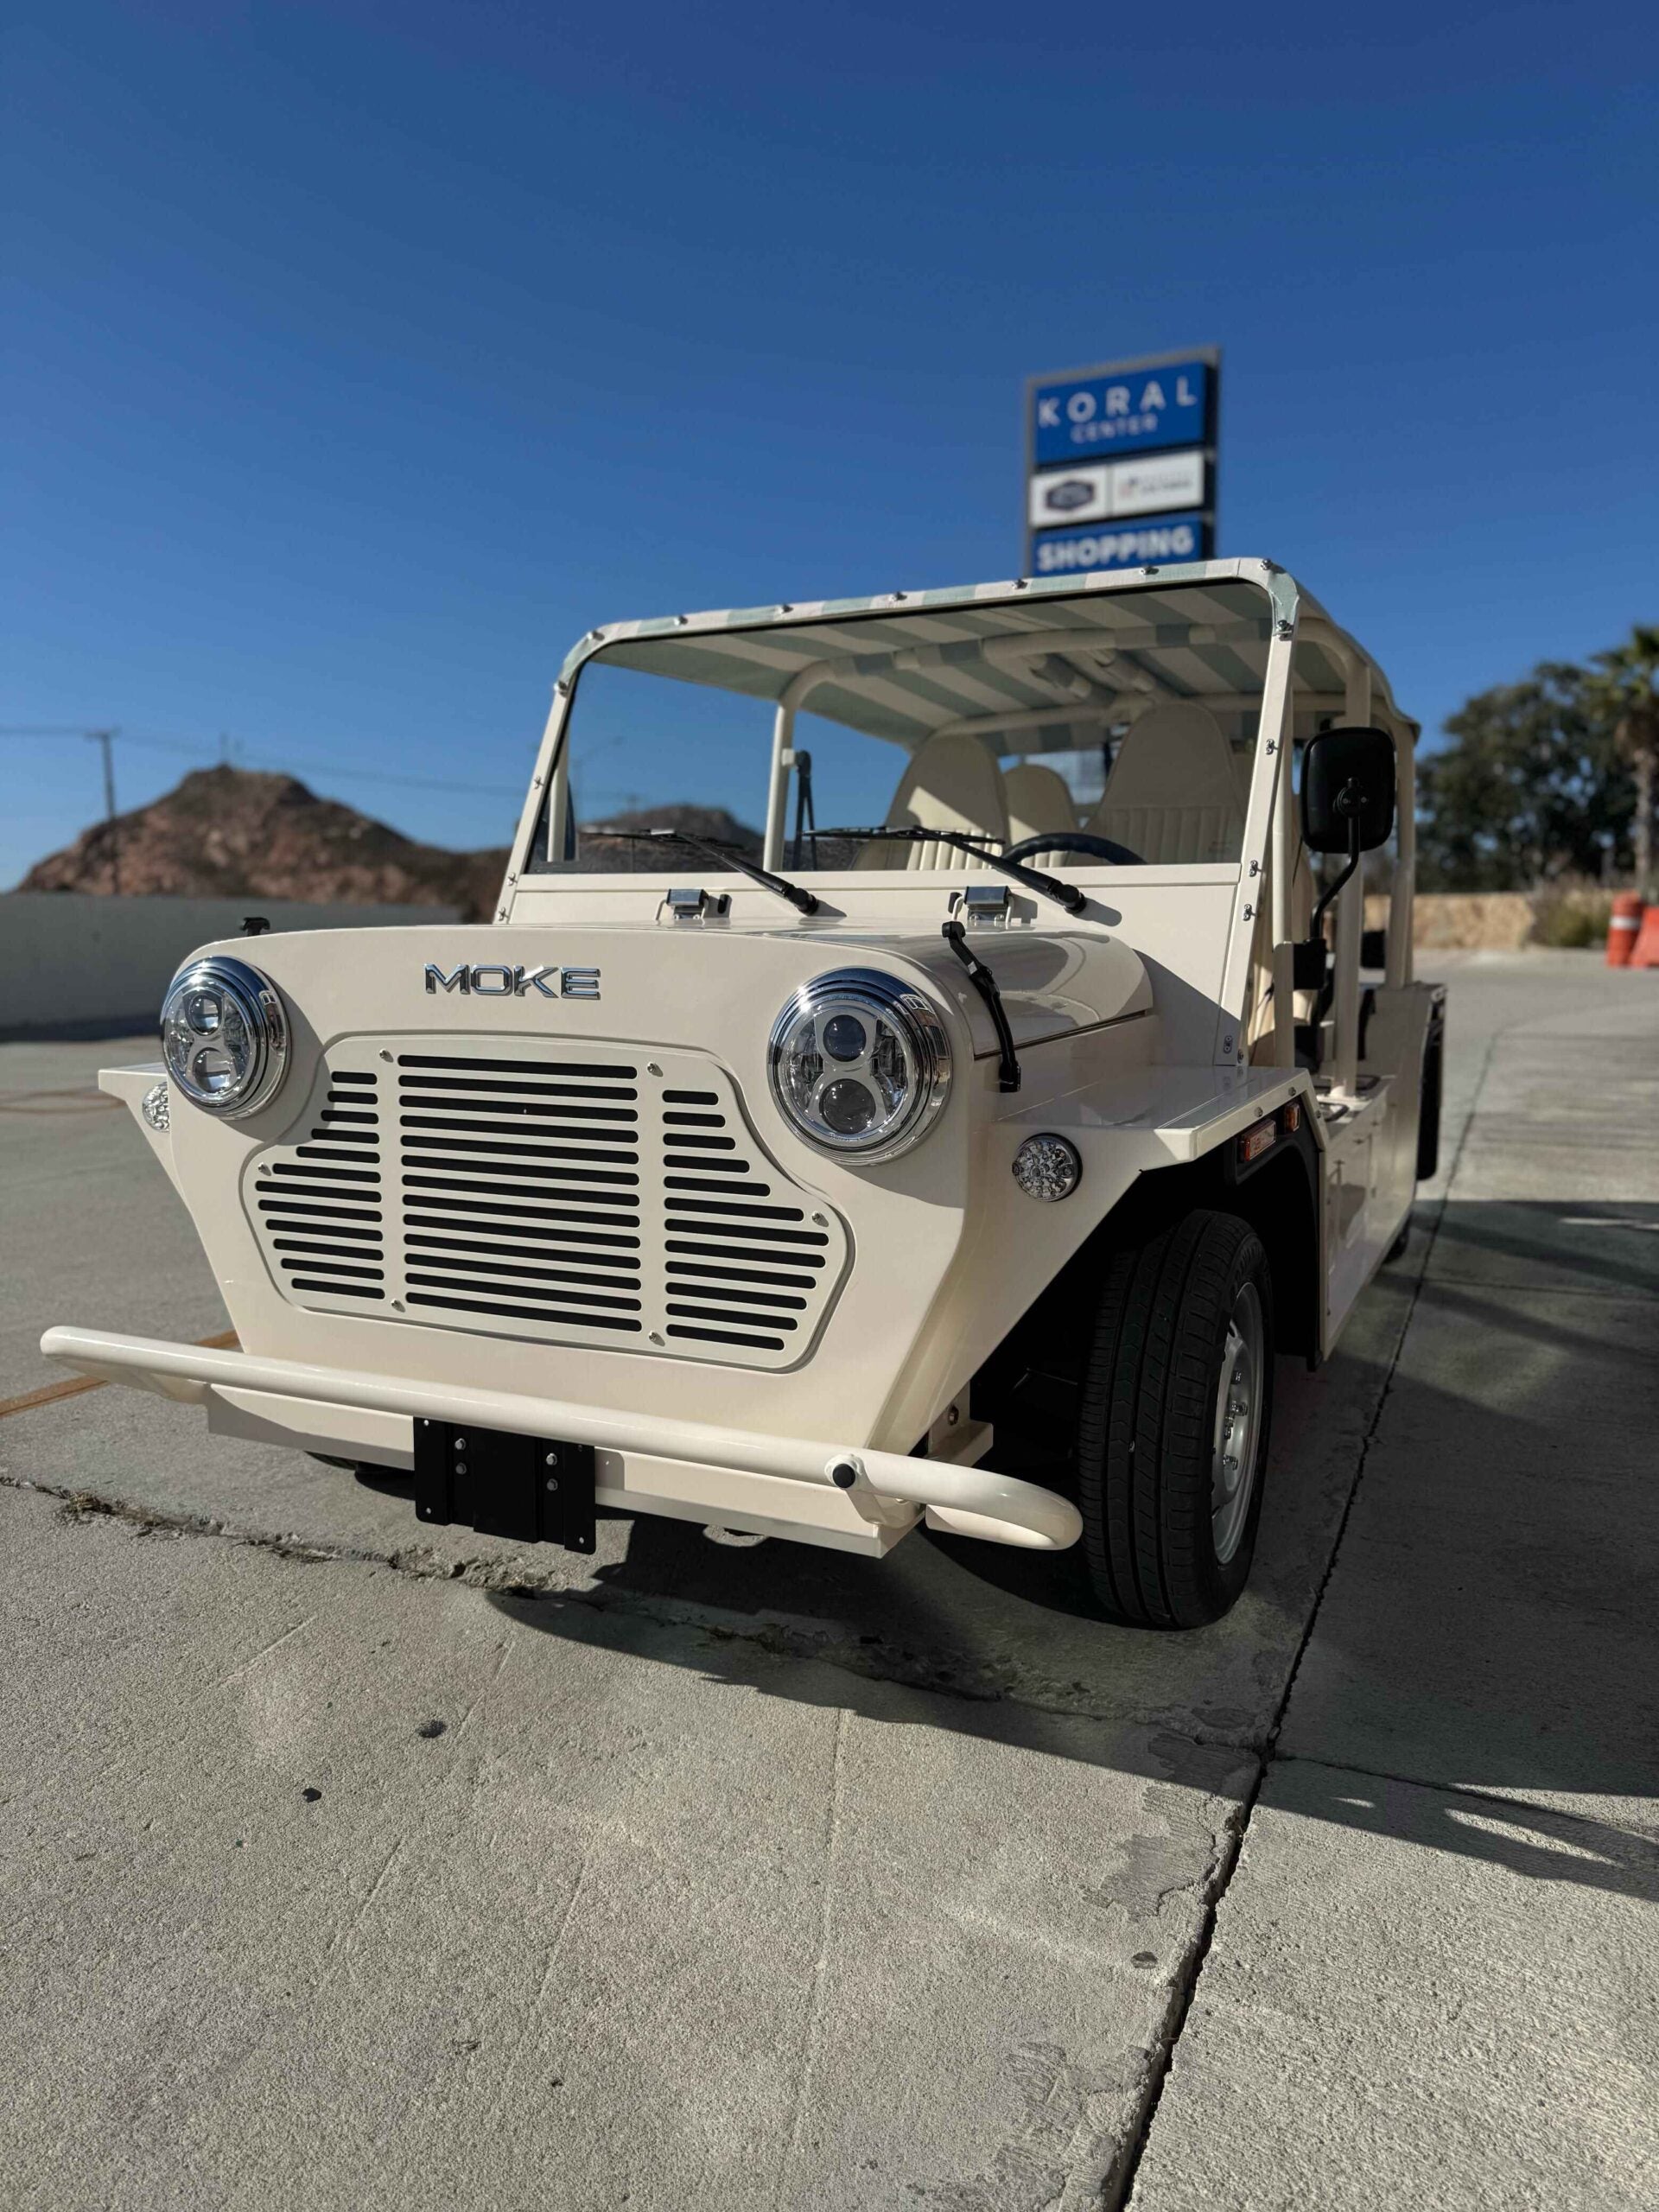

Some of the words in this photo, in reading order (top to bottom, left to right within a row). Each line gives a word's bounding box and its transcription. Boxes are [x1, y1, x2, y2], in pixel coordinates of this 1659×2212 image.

[1038, 376, 1198, 428] KORAL
[1070, 413, 1158, 443] CENTER
[1038, 525, 1194, 571] SHOPPING
[424, 963, 601, 1000] MOKE
